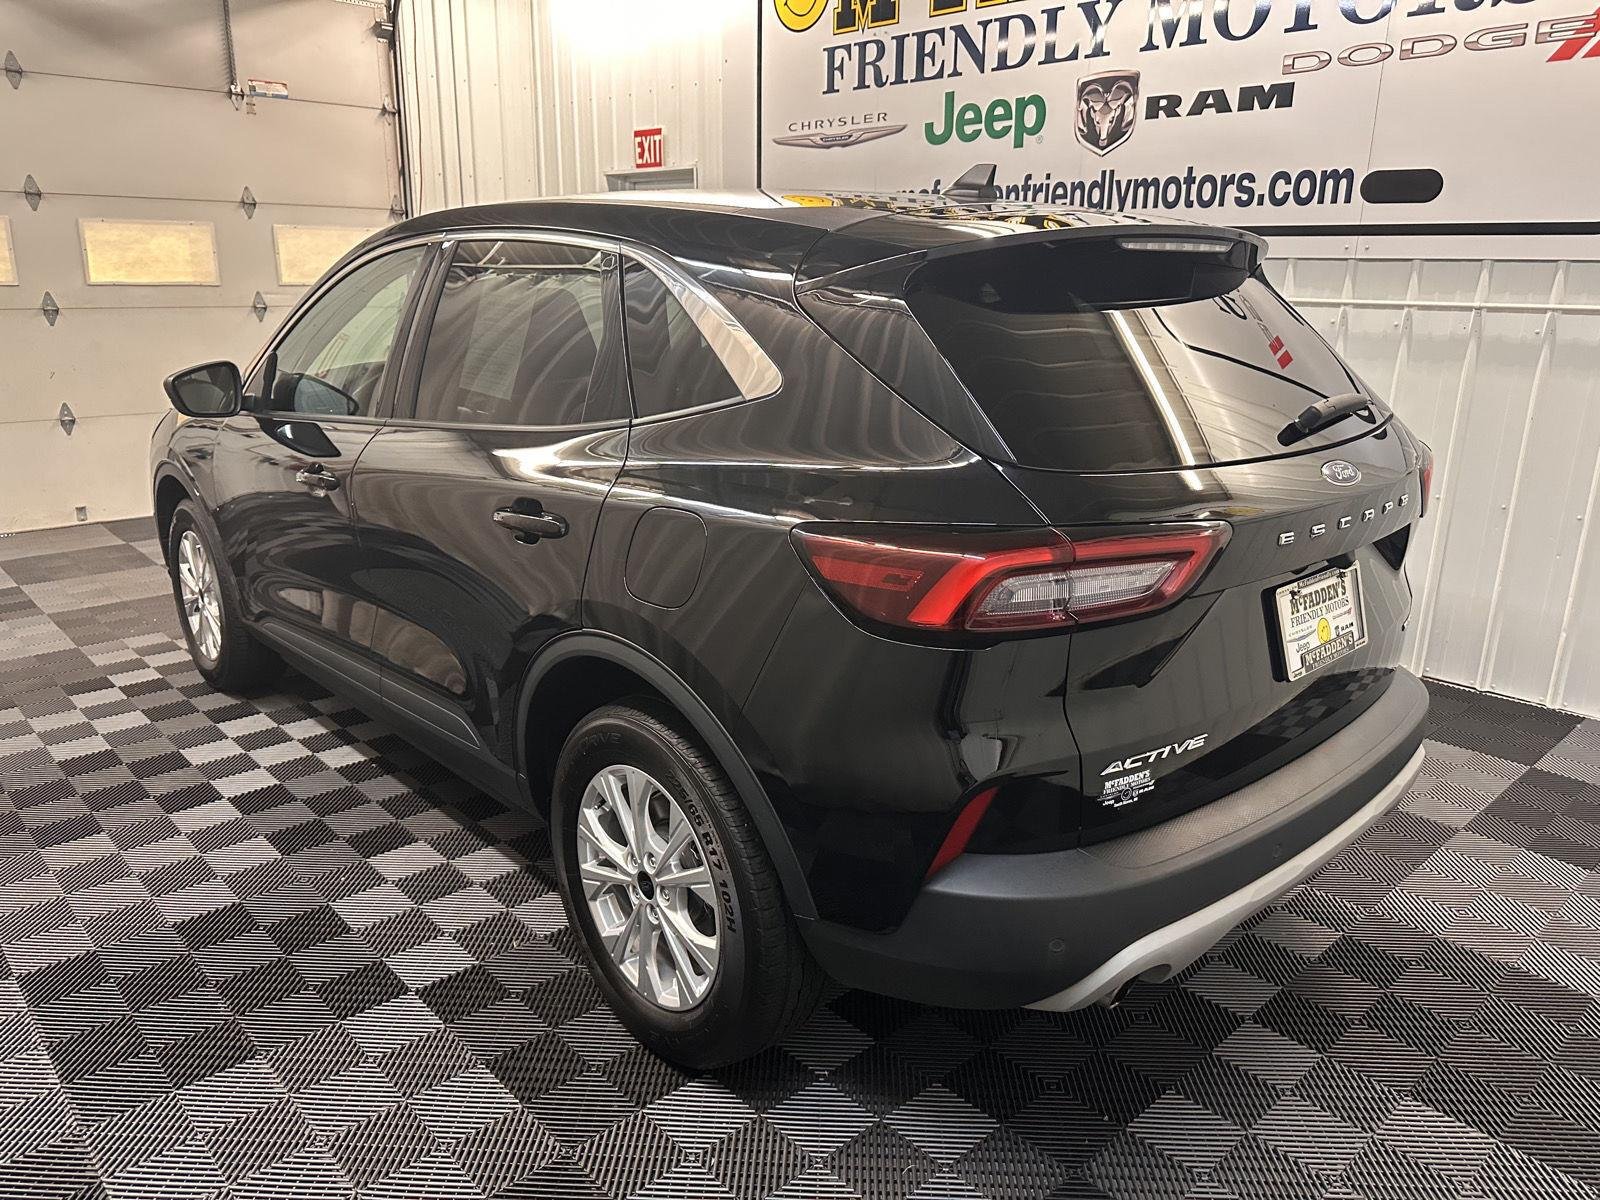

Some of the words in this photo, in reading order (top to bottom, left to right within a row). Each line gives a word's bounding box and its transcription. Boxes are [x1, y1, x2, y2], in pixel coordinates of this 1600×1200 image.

[822, 0, 1121, 95] FRIENDLY
[1282, 13, 1600, 75] DODGE
[788, 112, 888, 131] CHRYSLER
[924, 91, 1046, 148] Jeep
[1145, 82, 1295, 119] RAM
[634, 134, 661, 165] EXIT
[1332, 463, 1355, 480] Ford
[1278, 494, 1410, 547] ESCAPE
[1100, 733, 1208, 776] ACTIVE
[701, 831, 724, 871] R17
[719, 879, 737, 934] 102H
